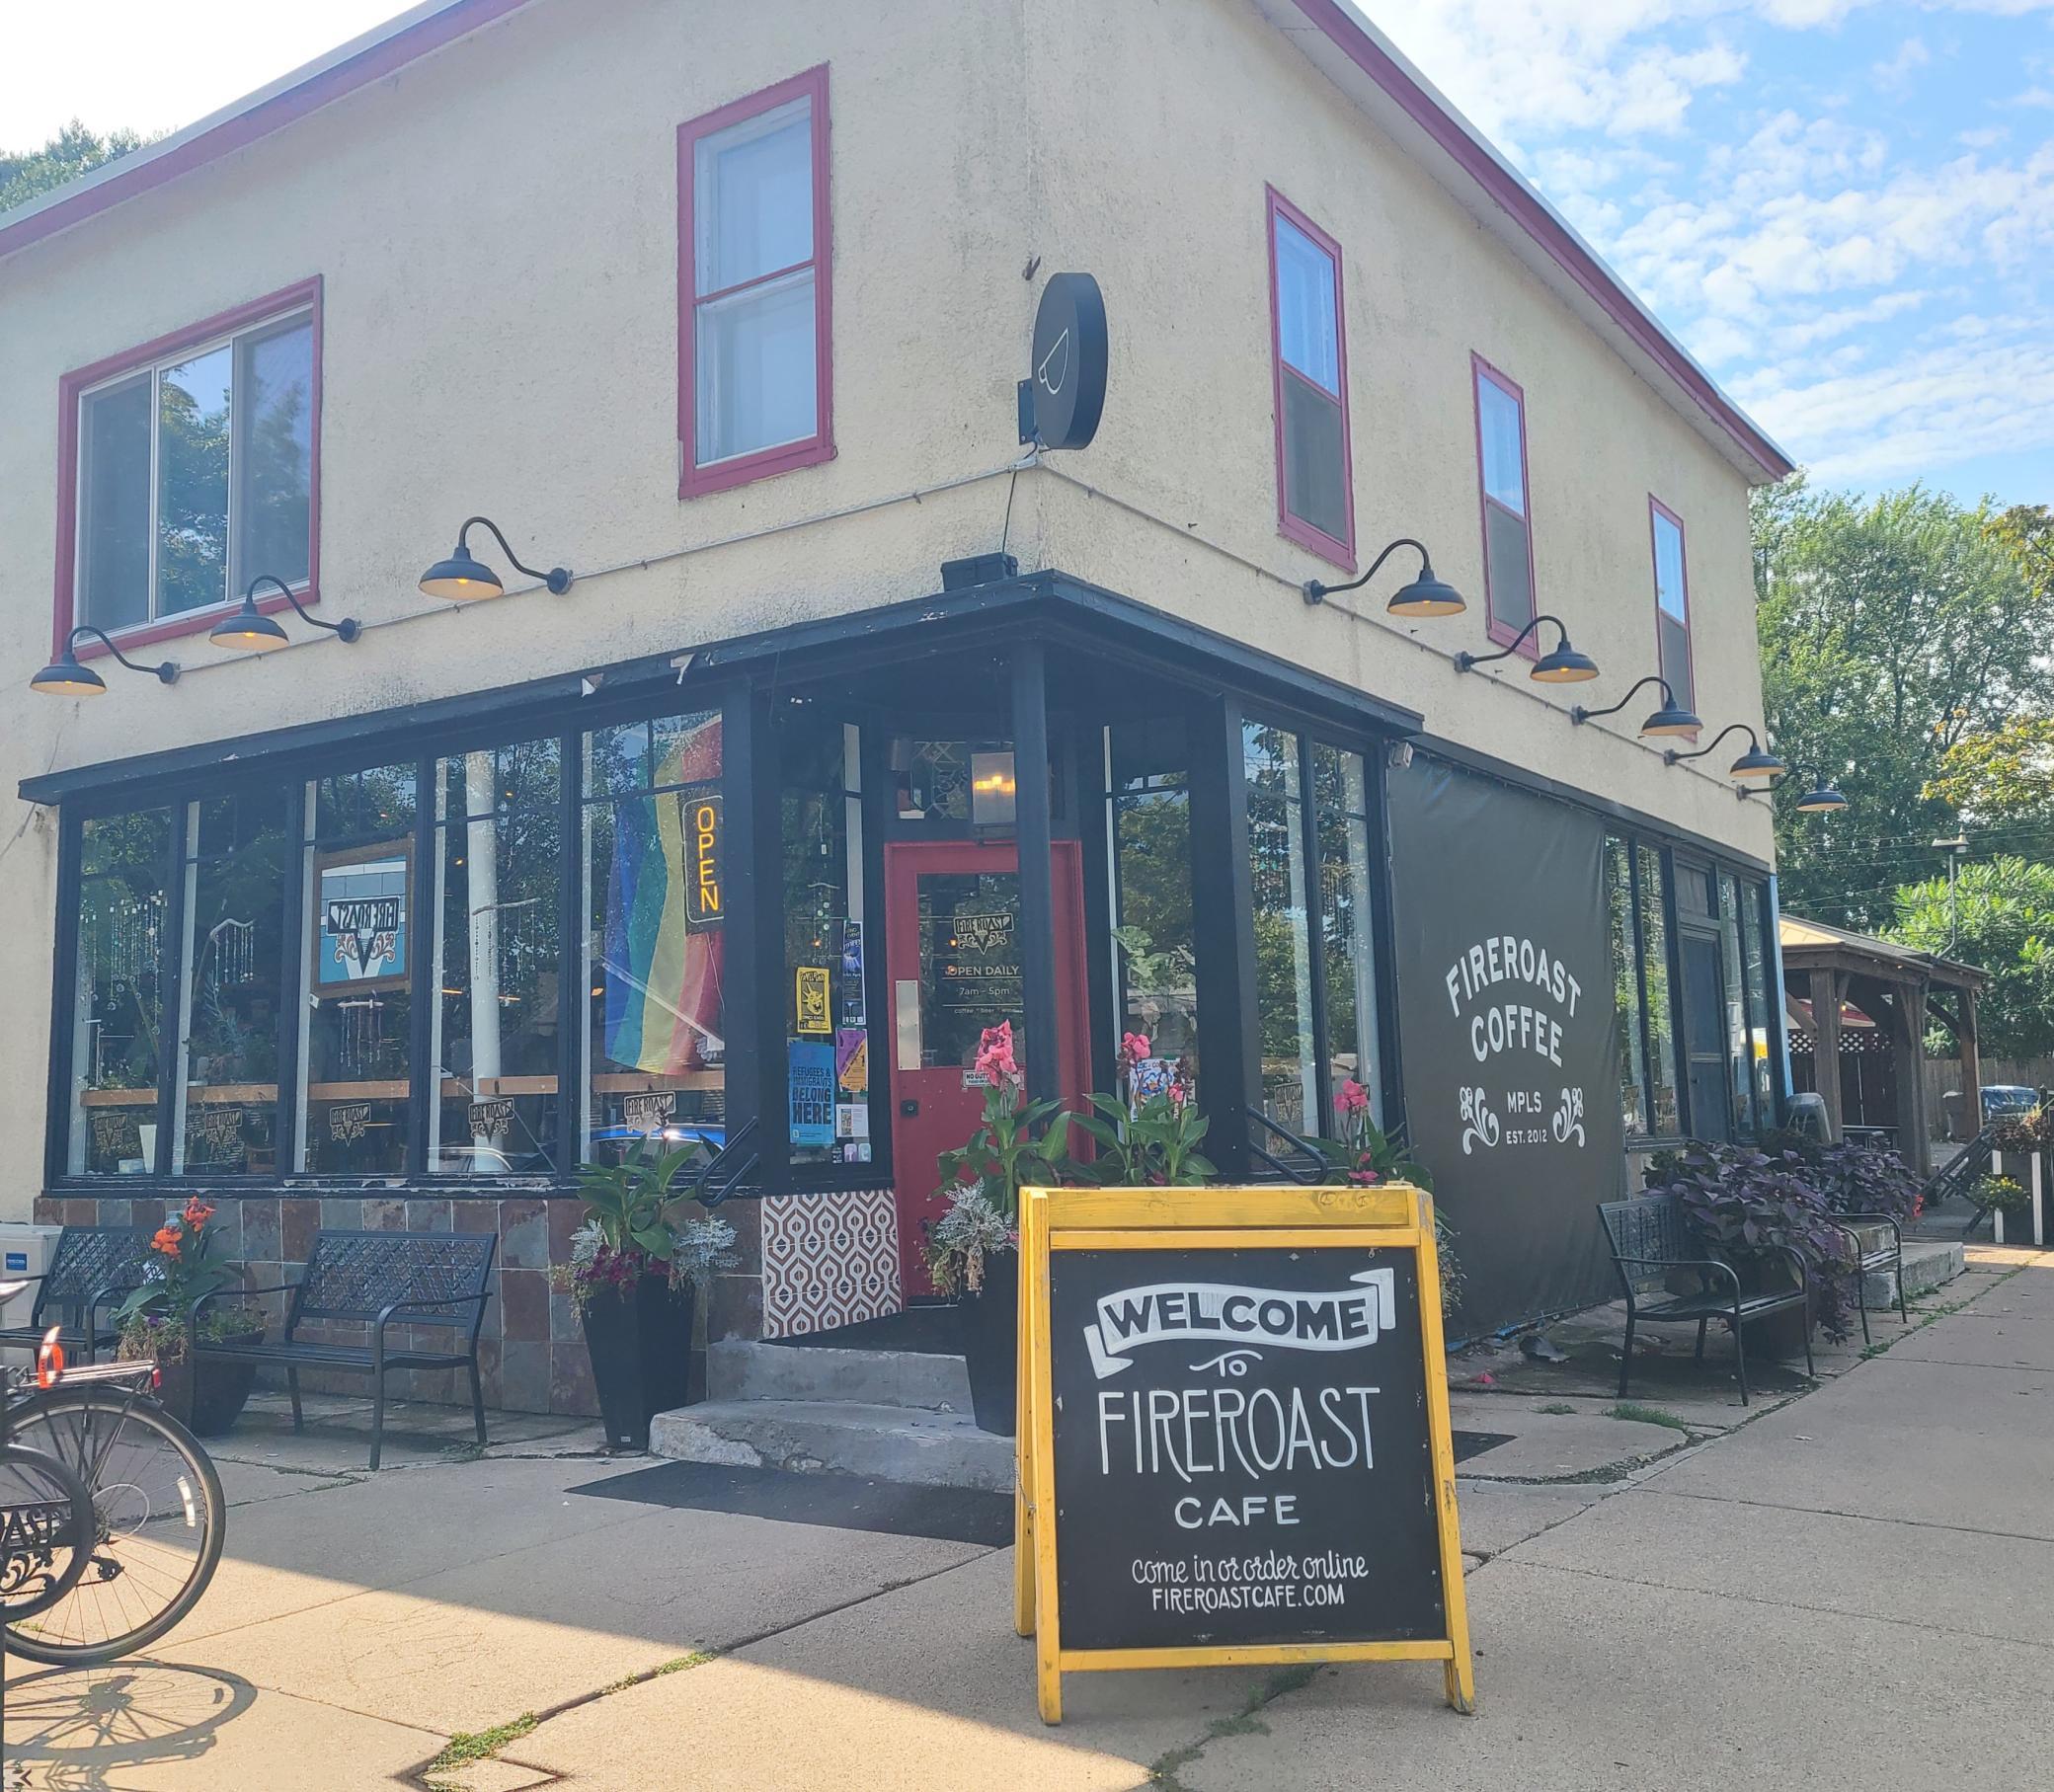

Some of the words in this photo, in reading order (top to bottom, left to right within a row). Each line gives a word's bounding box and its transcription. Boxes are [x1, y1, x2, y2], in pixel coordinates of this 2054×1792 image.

[697, 807, 719, 913] OPEN
[948, 966, 982, 976] OPEN
[986, 966, 1019, 975] DAILY
[1446, 936, 1581, 1018] FIREROAST
[959, 987, 980, 996] 7am
[988, 987, 1010, 996] 5pm
[1471, 1005, 1562, 1068] COFFEE
[792, 1066, 824, 1077] REFUGEES
[792, 1087, 830, 1102] BELONG
[1507, 1091, 1542, 1114] MPLS
[793, 1103, 831, 1125] HERE
[1506, 1130, 1526, 1145] EST.
[1528, 1130, 1547, 1143] 2012
[1104, 1291, 1370, 1341] WELCOME
[1098, 1387, 1382, 1483] FIREROAST
[1174, 1496, 1300, 1529] CAFE
[1133, 1559, 1189, 1584] come
[1193, 1554, 1216, 1582] in
[1219, 1557, 1241, 1581] or
[1243, 1549, 1300, 1581] order
[1303, 1549, 1369, 1580] online
[1152, 1584, 1345, 1613] FIREROASTCAFE.COM
